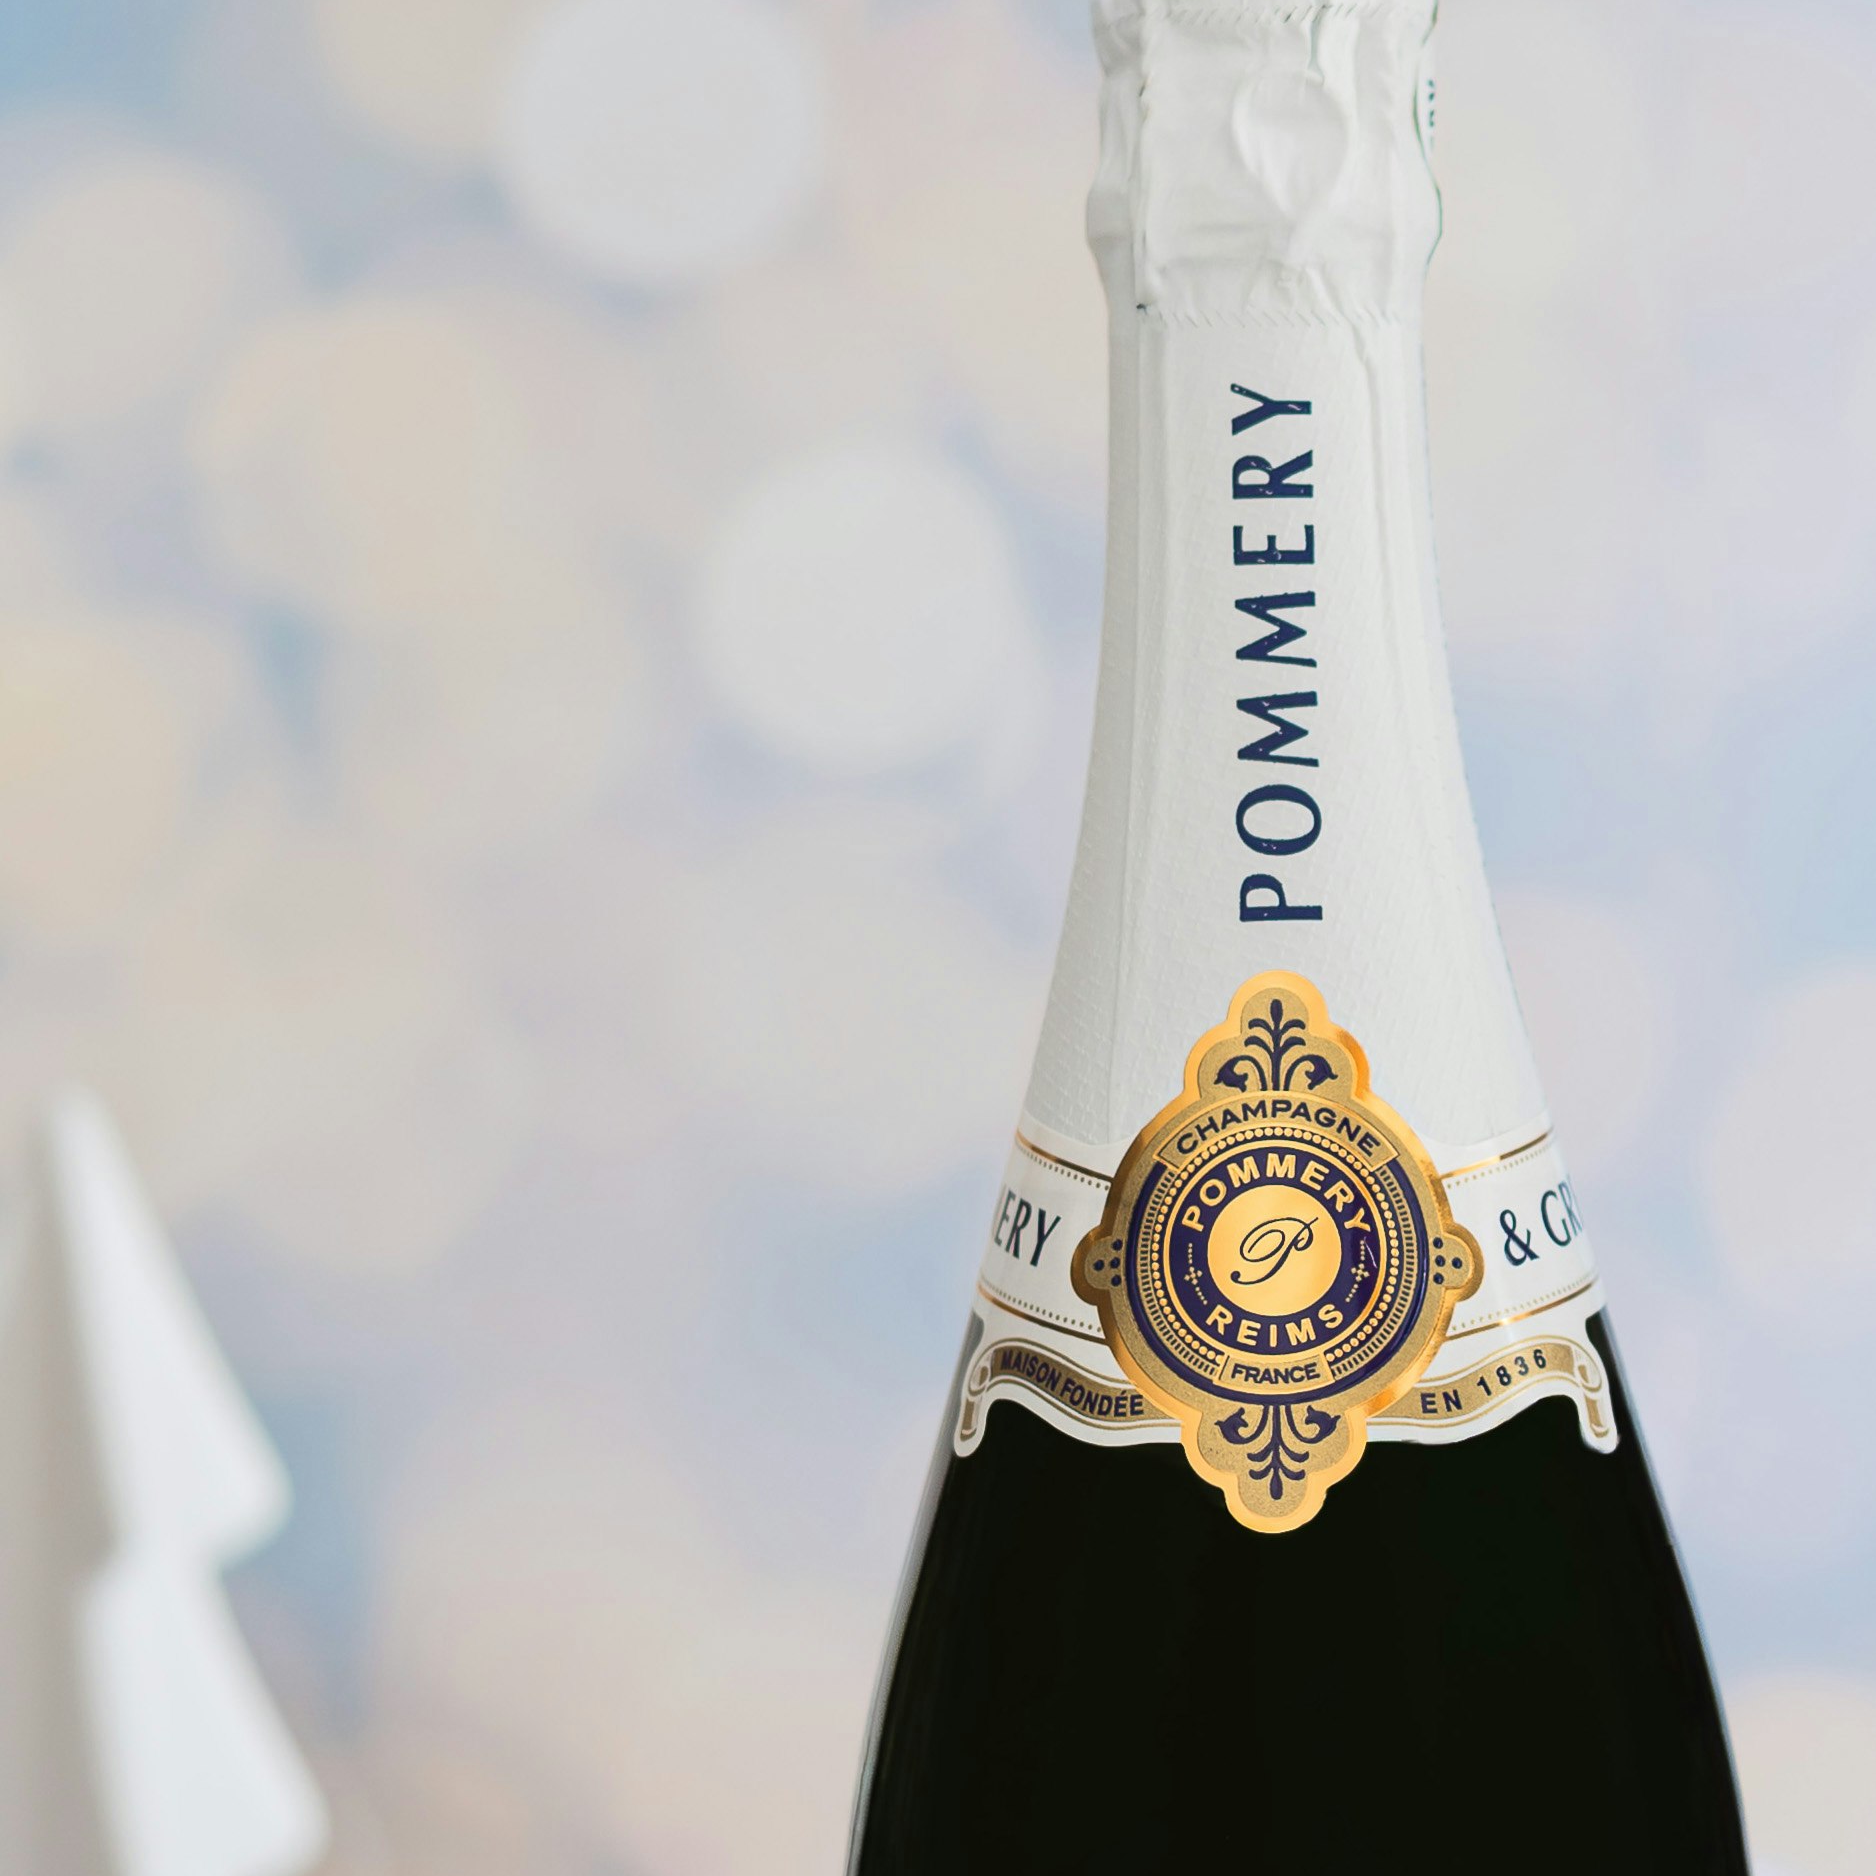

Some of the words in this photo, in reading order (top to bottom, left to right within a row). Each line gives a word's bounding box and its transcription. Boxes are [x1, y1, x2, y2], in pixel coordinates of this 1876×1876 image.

[1230, 382, 1324, 924] POMMERY
[1176, 1099, 1382, 1157] CHAMPAGNE
[1184, 1153, 1371, 1233] POMMERY
[1499, 1209, 1540, 1267] &
[1206, 1302, 1345, 1348] REIMS
[1001, 1348, 1060, 1391] MAISON
[1061, 1376, 1145, 1417] FONDÉE
[1420, 1389, 1463, 1414] EN
[1476, 1347, 1548, 1397] 1836
[1230, 1361, 1321, 1385] FRANCE
